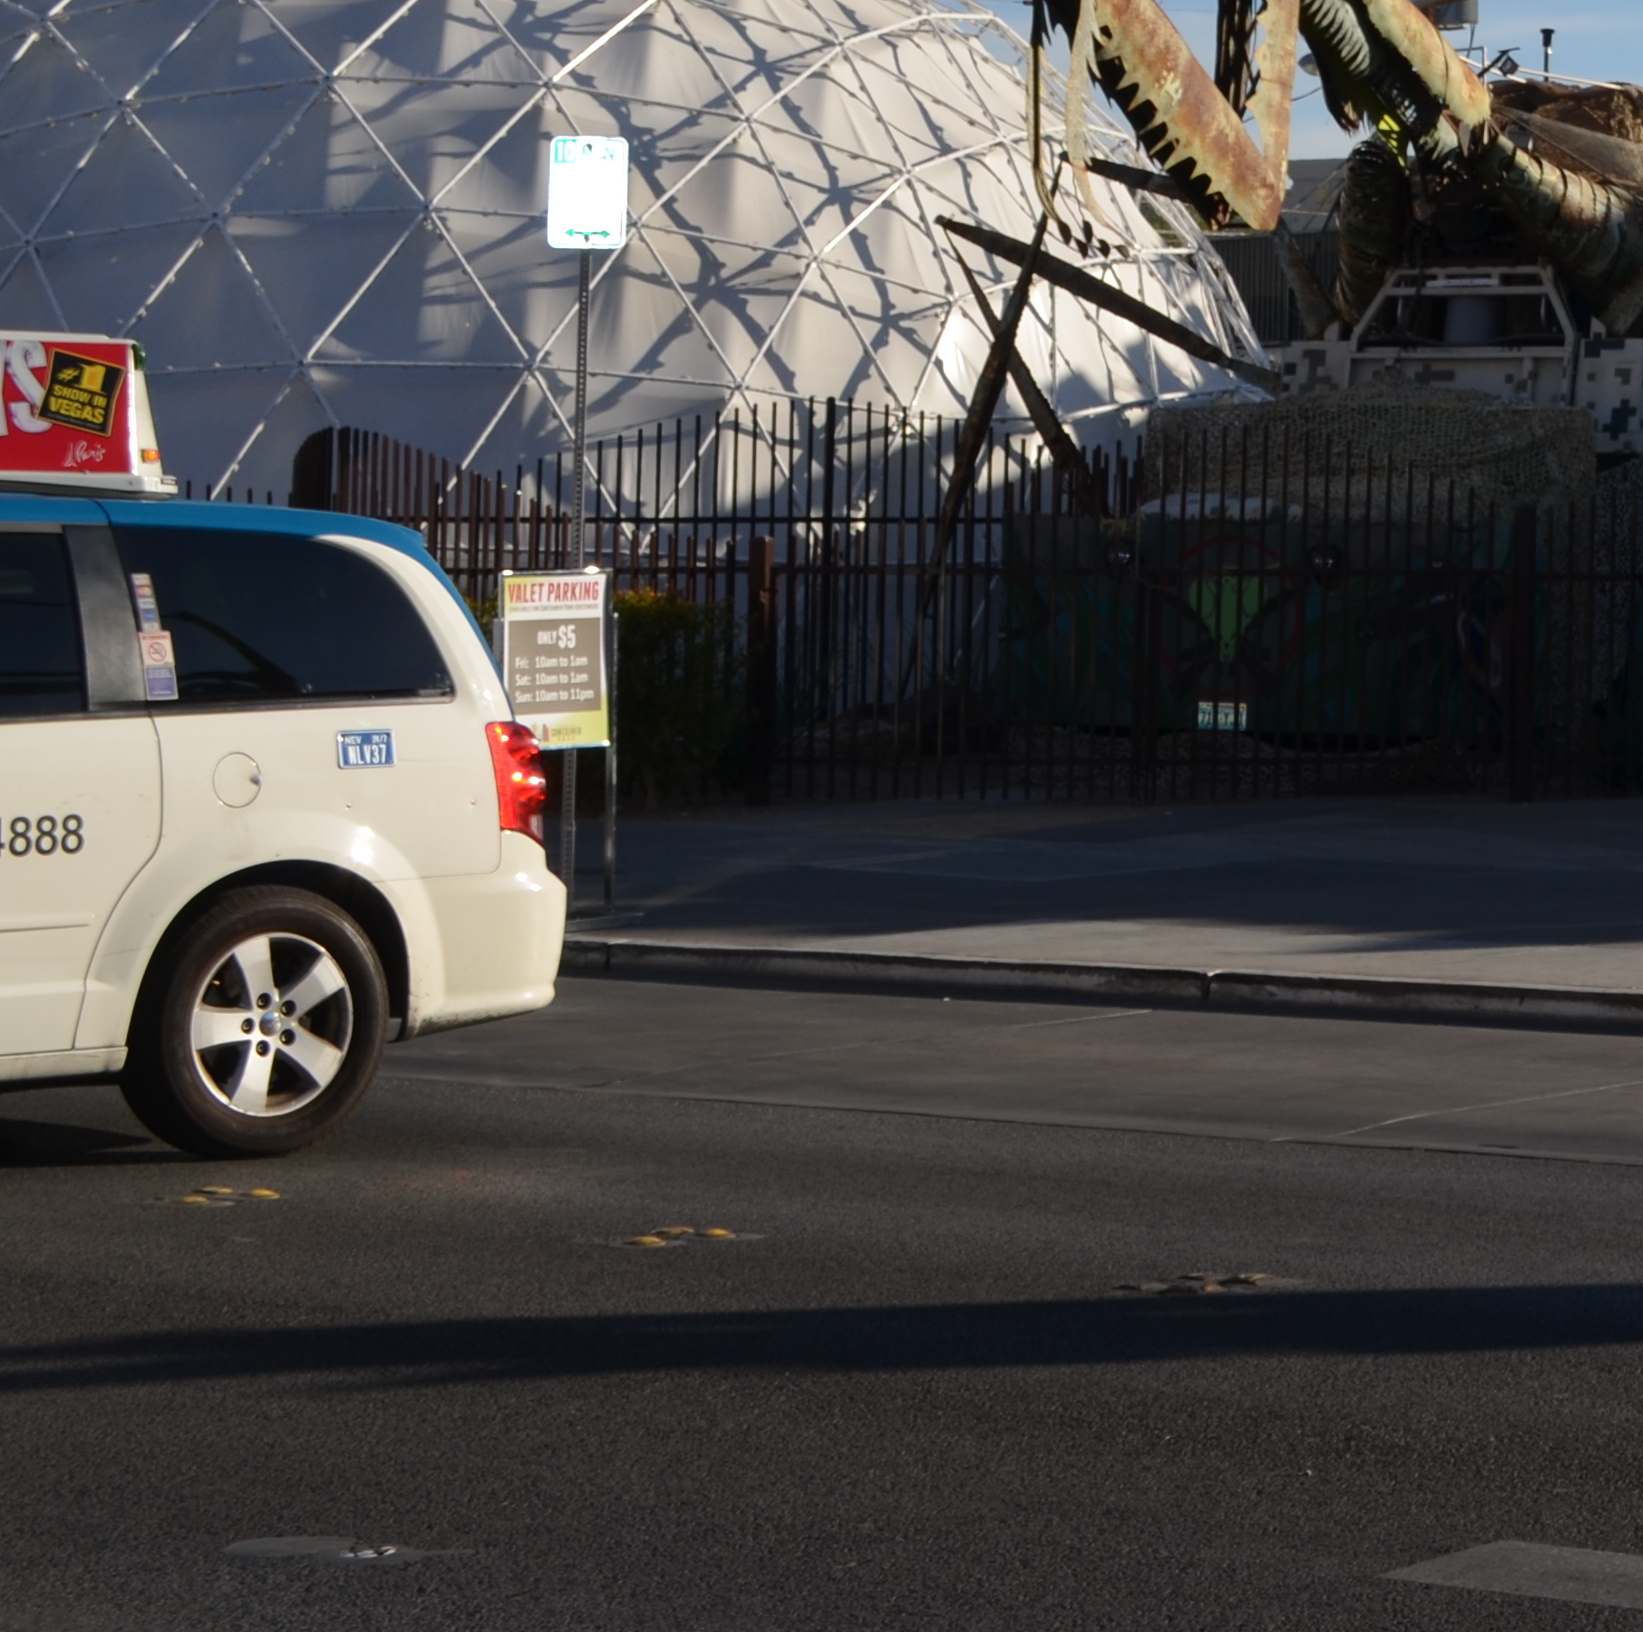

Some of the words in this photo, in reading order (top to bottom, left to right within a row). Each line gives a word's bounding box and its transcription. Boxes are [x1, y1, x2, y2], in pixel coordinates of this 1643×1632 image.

[56, 363, 107, 395] #1
[53, 383, 92, 403] SHOW
[93, 395, 108, 409] IN
[48, 396, 106, 425] VEGAS
[76, 439, 107, 464] Paris
[508, 582, 545, 604] VALET
[547, 580, 600, 603] PARKING
[537, 630, 557, 645] ONLY
[558, 623, 577, 649] $5
[515, 656, 530, 669] Fri:
[535, 655, 558, 668] 10am
[559, 655, 568, 668] to
[570, 654, 588, 667] 1am
[515, 673, 531, 687] Sat:
[535, 672, 558, 685] 10am
[559, 672, 568, 684] to
[570, 671, 588, 684] 1am
[515, 690, 533, 703] Sun:
[535, 689, 558, 702] 10am
[559, 689, 568, 701] to
[570, 687, 594, 703] 11pm
[0, 814, 84, 858] 888
